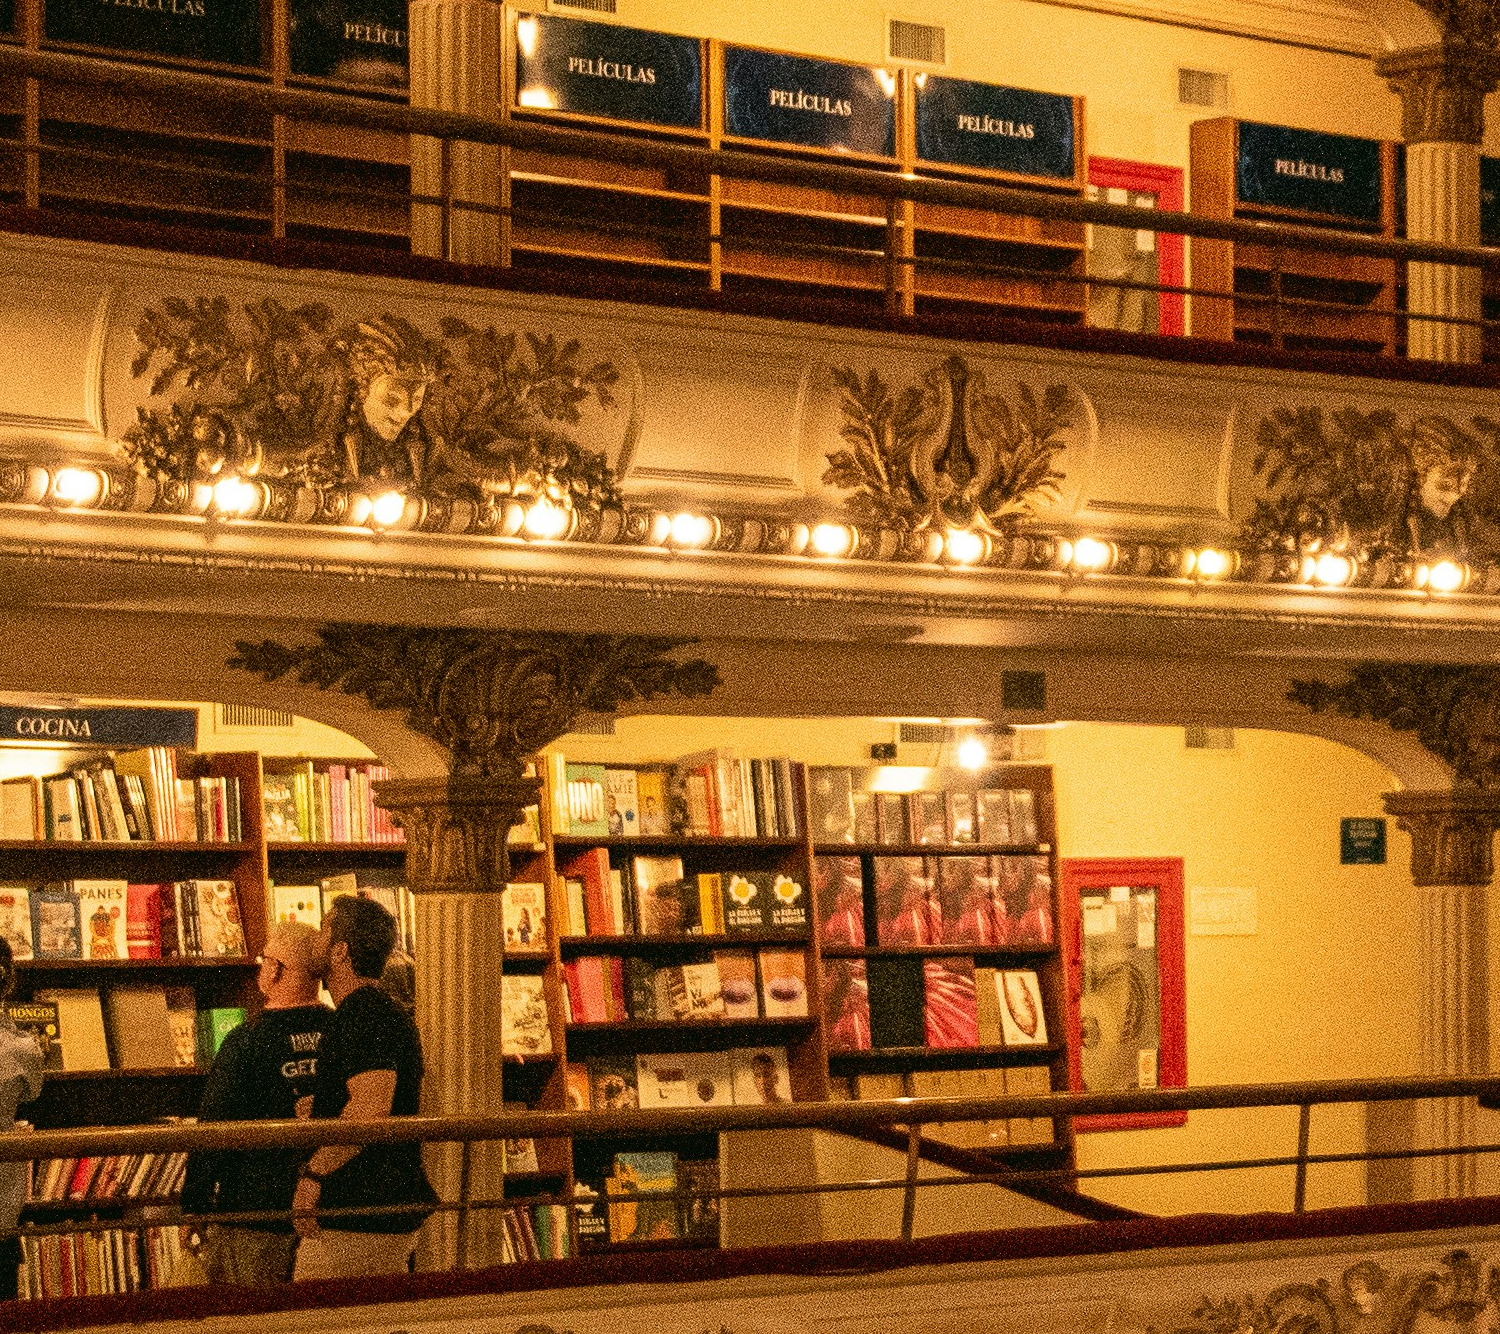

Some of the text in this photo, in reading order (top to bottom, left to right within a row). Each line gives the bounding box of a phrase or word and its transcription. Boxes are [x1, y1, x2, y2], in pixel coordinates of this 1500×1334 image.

[568, 55, 656, 85] PELÍCULAS
[769, 87, 852, 117] PELÍCULAS
[957, 113, 1035, 140] PELÍCULAS
[1274, 157, 1345, 184] PELÍCULAS
[16, 716, 92, 738] COCINA
